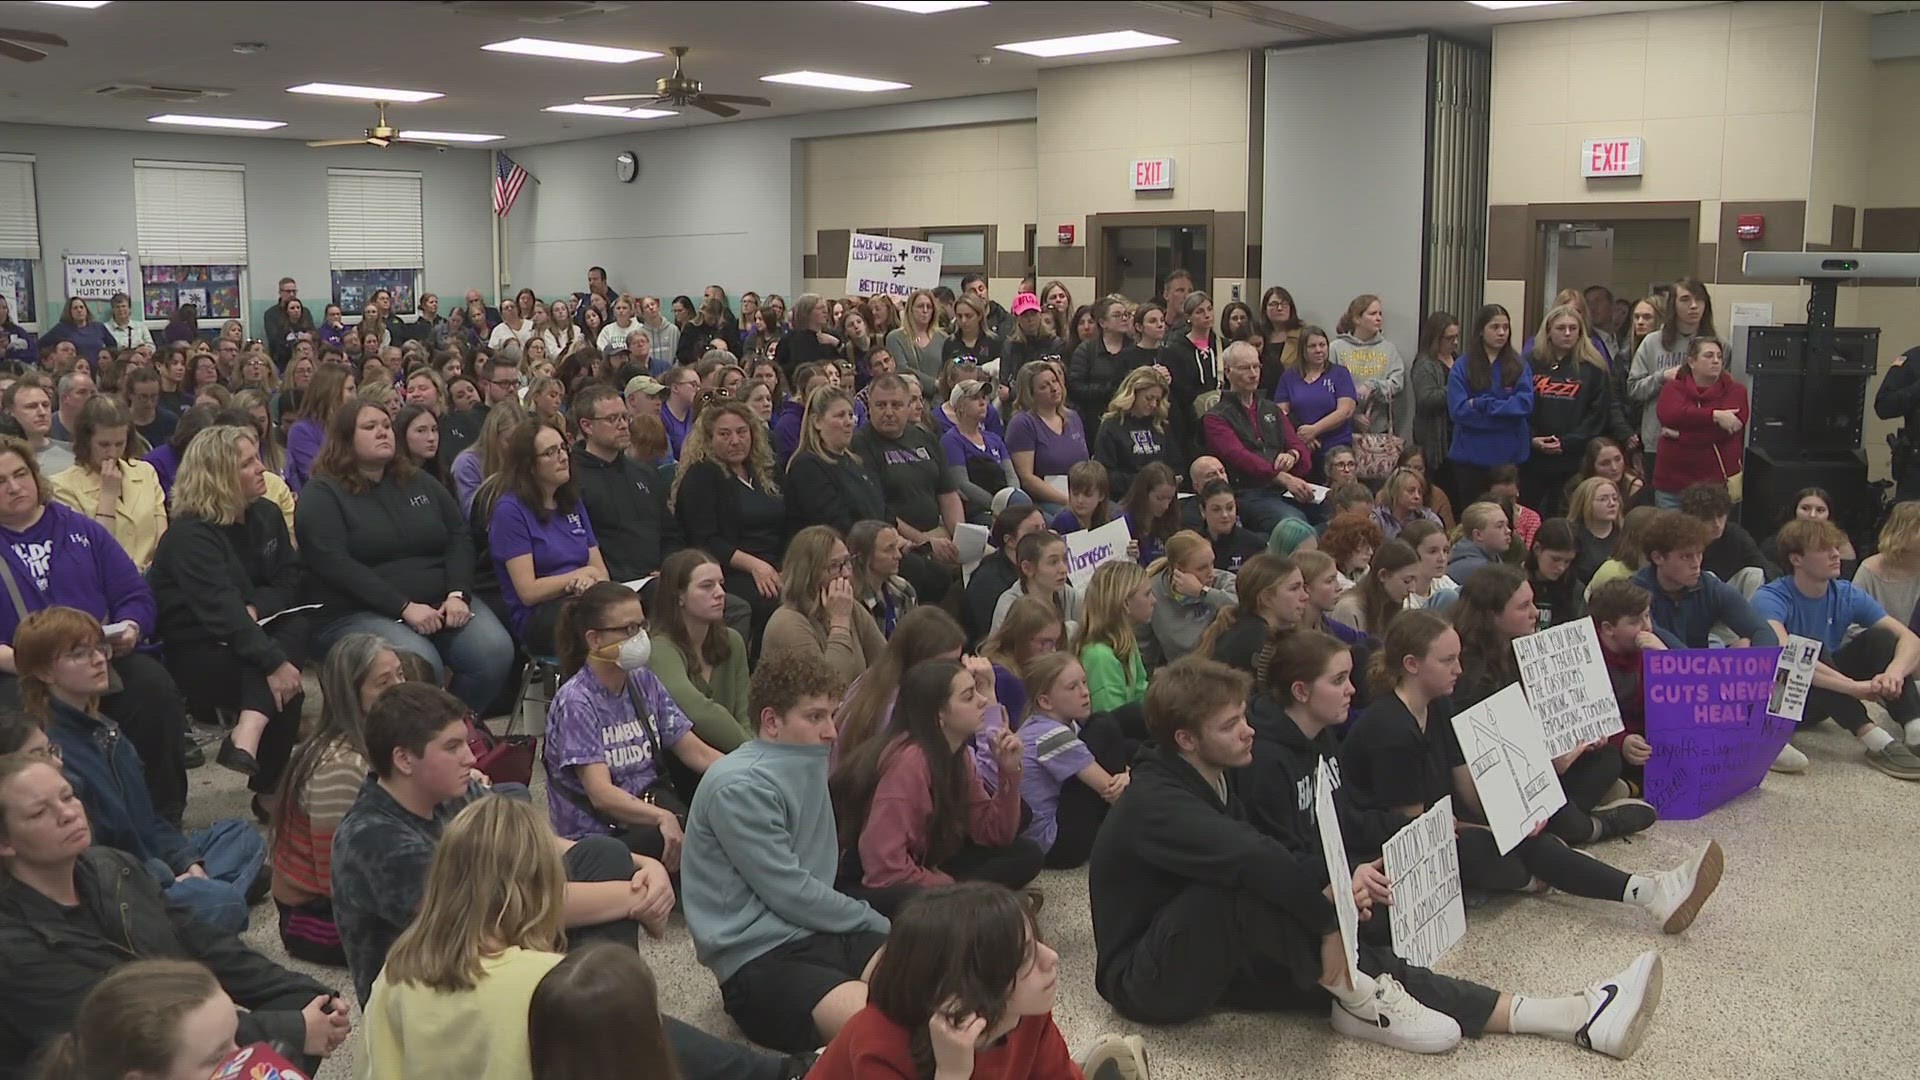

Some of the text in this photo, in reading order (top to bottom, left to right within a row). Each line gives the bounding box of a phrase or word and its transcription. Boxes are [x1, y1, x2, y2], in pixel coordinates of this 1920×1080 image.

[1592, 142, 1629, 171] EXIT
[1136, 161, 1162, 185] EXIT
[67, 258, 125, 266] LEARNING FIRST
[75, 288, 101, 296] HURT
[80, 279, 117, 287] LAYOFFS
[859, 279, 888, 294] BETTER
[1650, 655, 1772, 676] EDUCATION
[1650, 682, 1709, 703] CUTS
[1694, 703, 1754, 727] HEAL!
[1385, 809, 1448, 878] EDUCATORS SHOULD
[1391, 839, 1457, 922] NOT PAY THE PRICE
[1393, 912, 1411, 947] FOR
